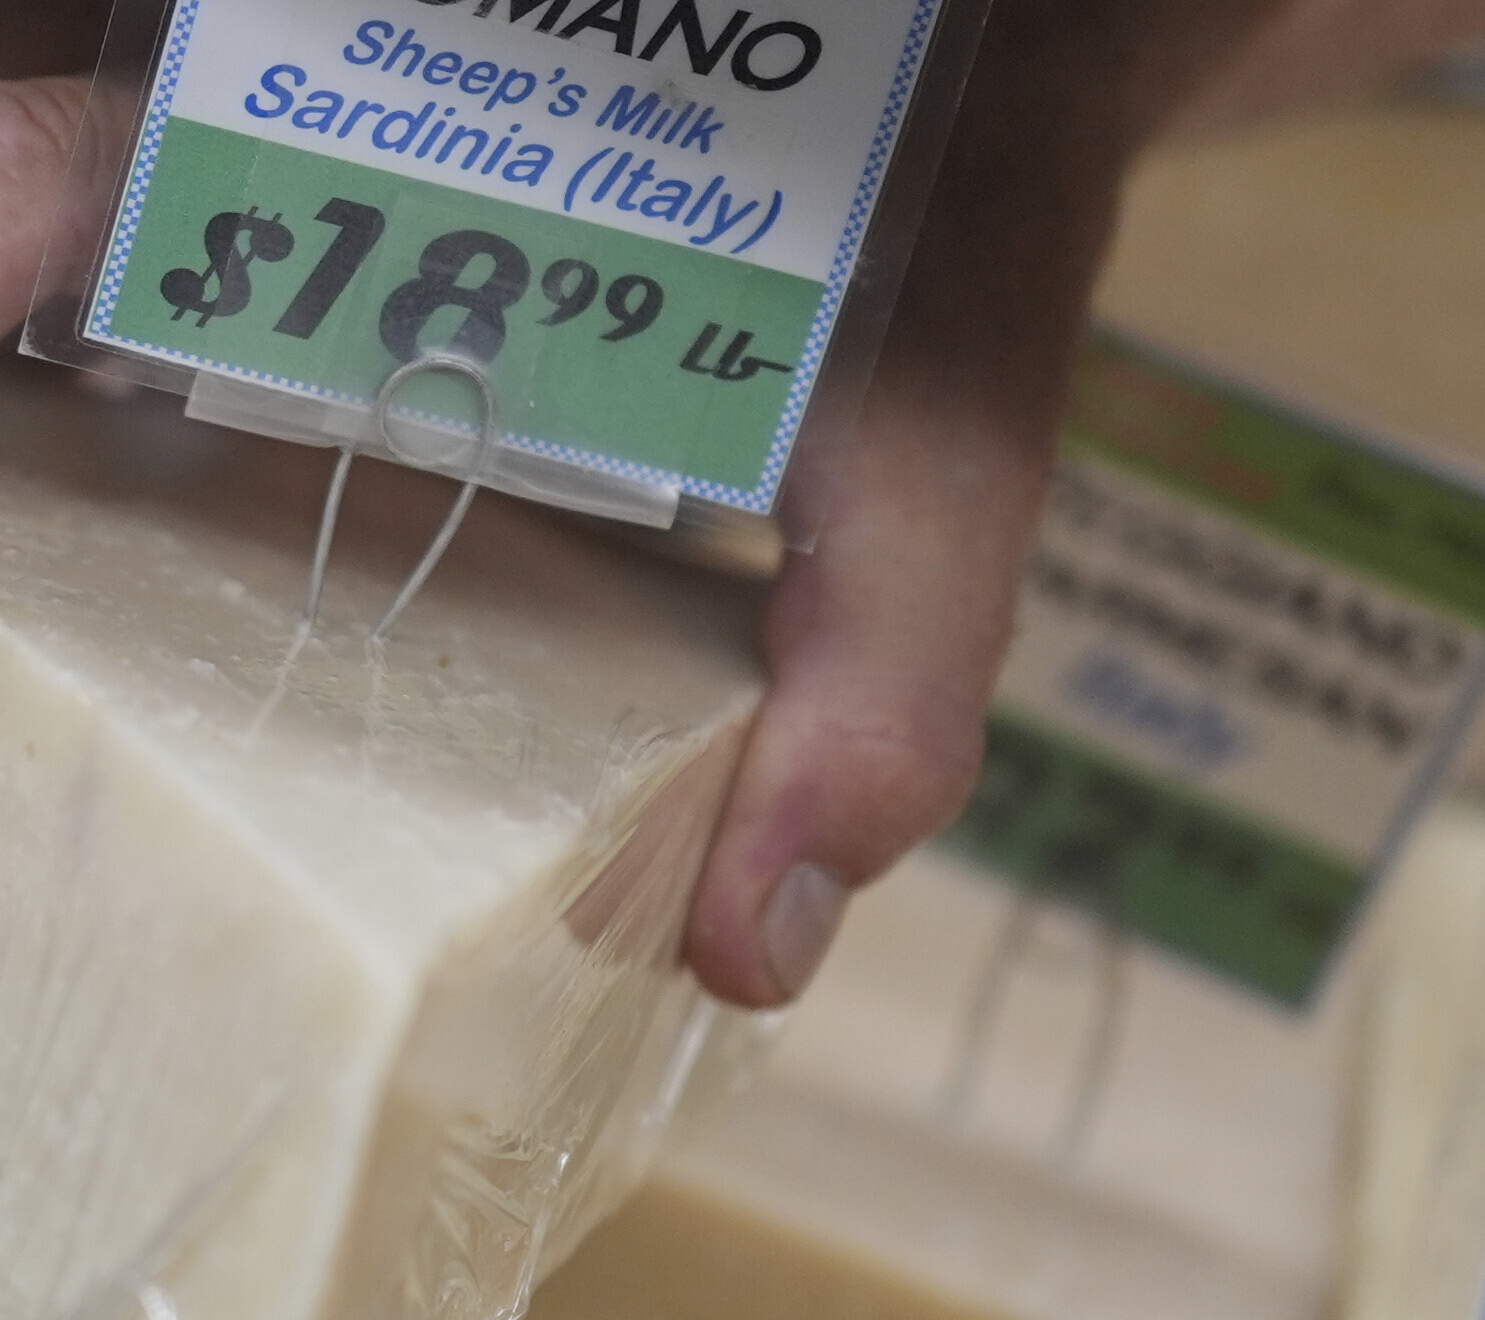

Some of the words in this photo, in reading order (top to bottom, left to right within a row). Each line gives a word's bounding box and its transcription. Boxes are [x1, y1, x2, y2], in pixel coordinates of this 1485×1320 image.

[243, 63, 554, 188] Sardinia
[562, 145, 783, 256] (Italy)
[343, 19, 587, 118] Sheep's
[597, 83, 727, 154] Milk
